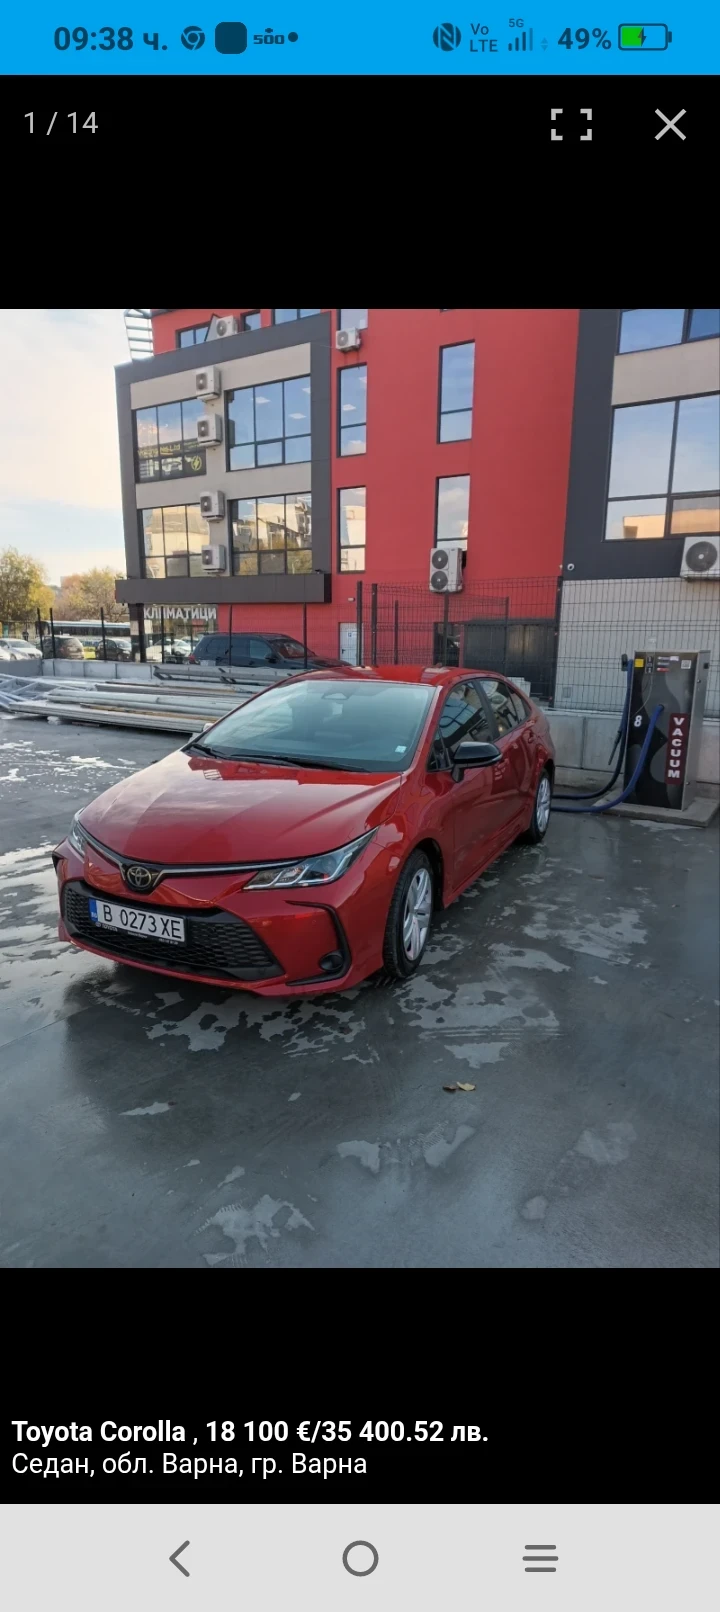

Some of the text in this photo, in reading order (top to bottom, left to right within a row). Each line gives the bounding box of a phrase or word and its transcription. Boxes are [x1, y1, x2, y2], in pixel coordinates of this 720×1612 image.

[633, 715, 642, 727] 8
[667, 717, 684, 778] VACUUM
[103, 904, 182, 939] B 0273 XE
